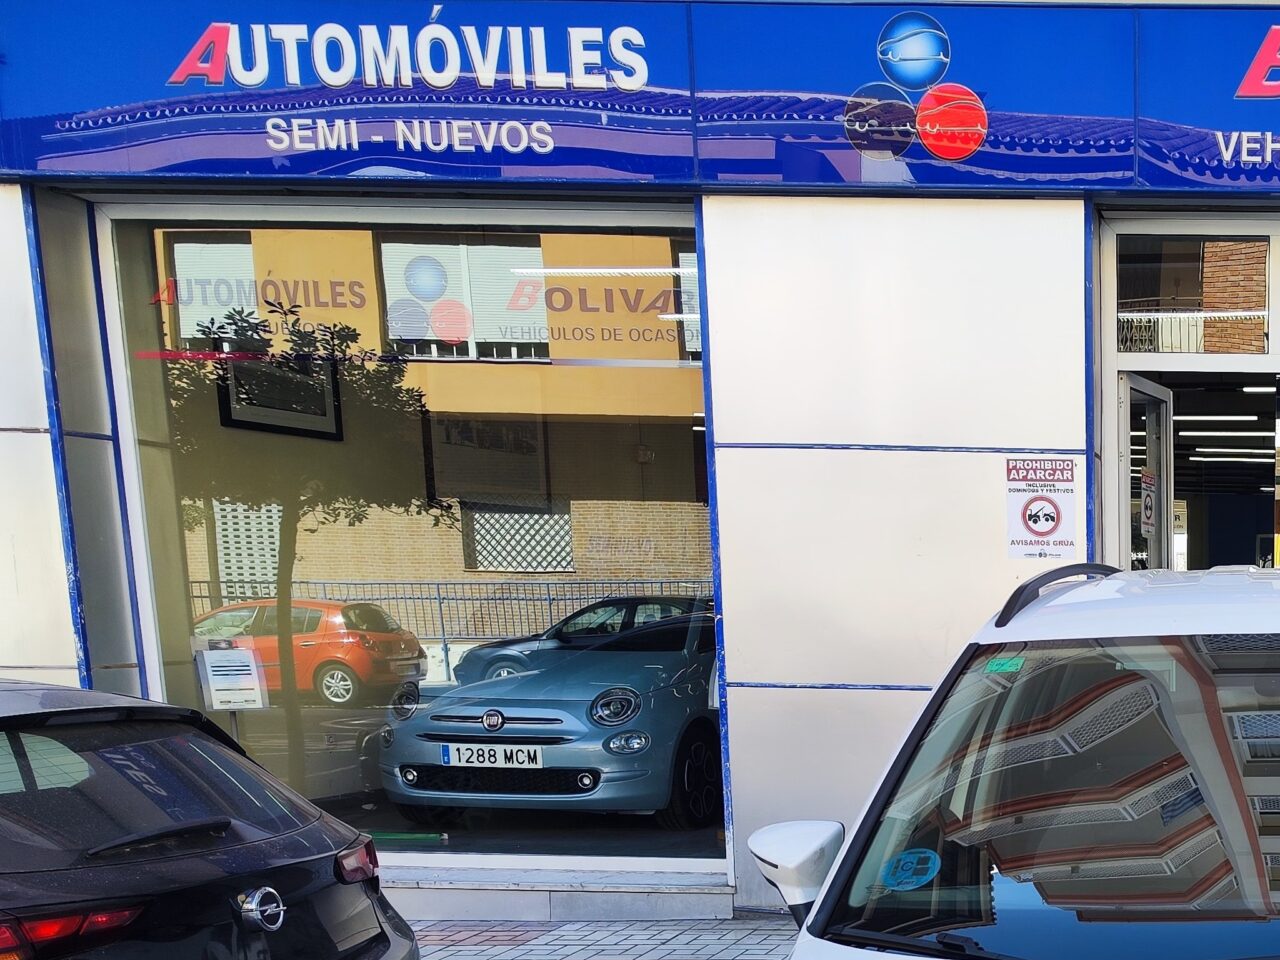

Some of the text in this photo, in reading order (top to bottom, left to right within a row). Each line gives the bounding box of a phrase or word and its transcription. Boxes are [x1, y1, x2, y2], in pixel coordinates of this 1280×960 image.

[165, 4, 649, 91] AUTOMÓVILES
[265, 117, 359, 151] SEMI
[394, 119, 556, 154] NUEVOS
[150, 270, 367, 309] AUTOMÓVILES
[498, 322, 701, 343] VEHÍCULOS DE OCASÓ
[1008, 460, 1073, 469] PROHIBIDO
[1009, 470, 1073, 480] APARCAR
[1010, 539, 1051, 547] AVISAMOS
[455, 747, 538, 766] 1288 MCM
